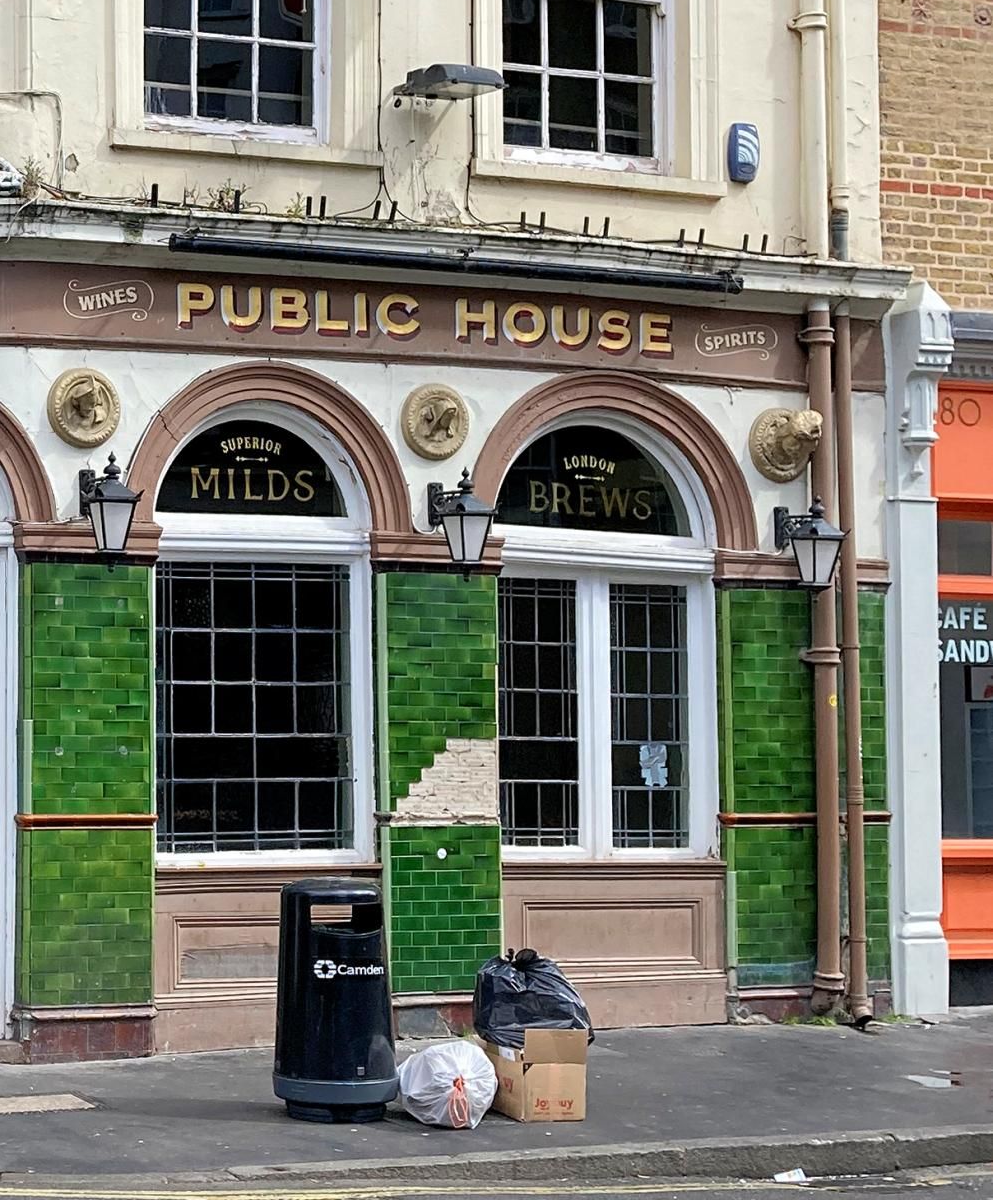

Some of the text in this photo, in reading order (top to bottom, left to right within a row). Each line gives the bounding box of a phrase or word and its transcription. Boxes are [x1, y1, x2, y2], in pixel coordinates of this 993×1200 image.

[78, 286, 138, 312] WINES
[176, 282, 674, 359] PUBLIC HOUSE
[704, 330, 766, 351] SPIRITS
[940, 396, 981, 426] 80
[220, 436, 282, 456] SUPERIOR
[563, 454, 616, 475] LONDON
[190, 466, 315, 502] MILDS
[529, 479, 652, 520] BREWS
[937, 639, 993, 663] AND
[337, 964, 385, 975] Camden
[535, 1098, 574, 1110] Jouy
